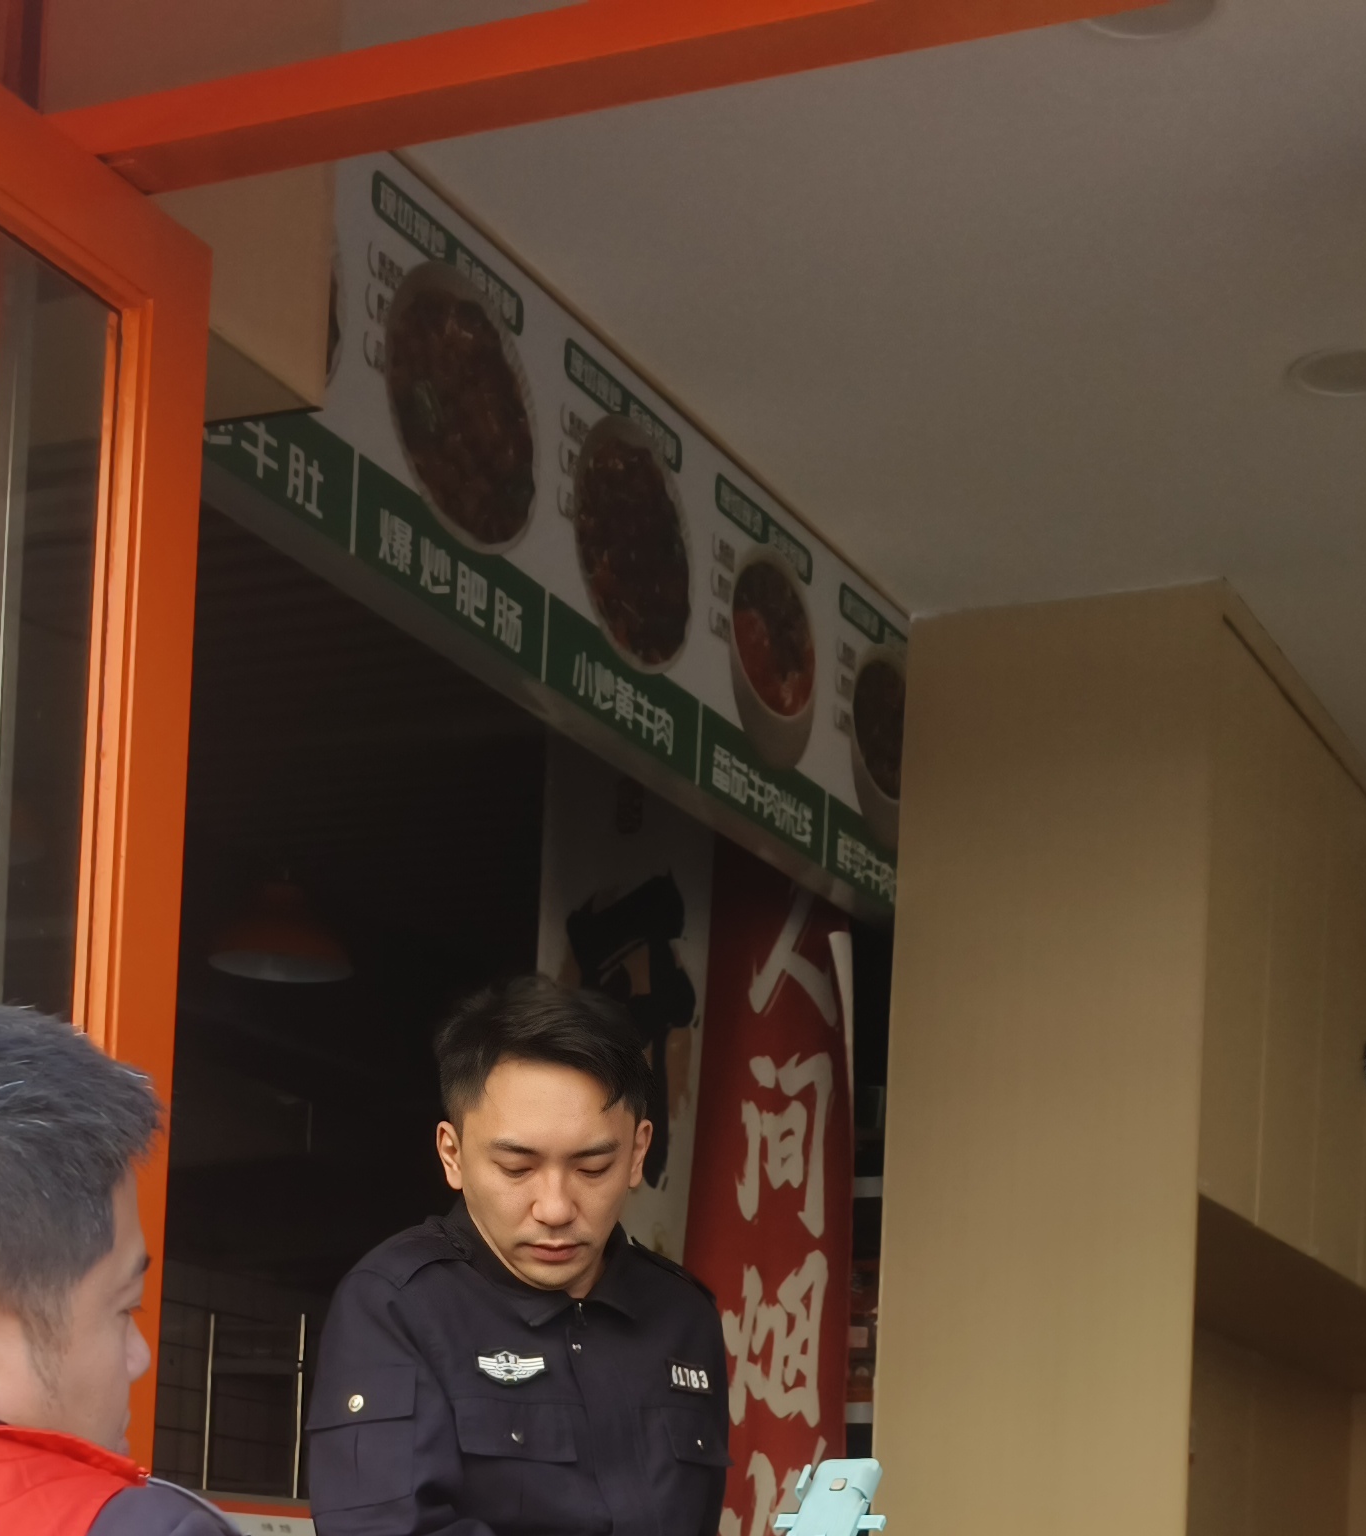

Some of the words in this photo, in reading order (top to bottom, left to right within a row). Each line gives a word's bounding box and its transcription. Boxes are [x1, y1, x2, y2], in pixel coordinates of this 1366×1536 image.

[378, 508, 523, 653] 爆炒肥肠
[572, 651, 674, 756] 小炒黄牛肉
[711, 743, 813, 847] 番茄牛肉米线
